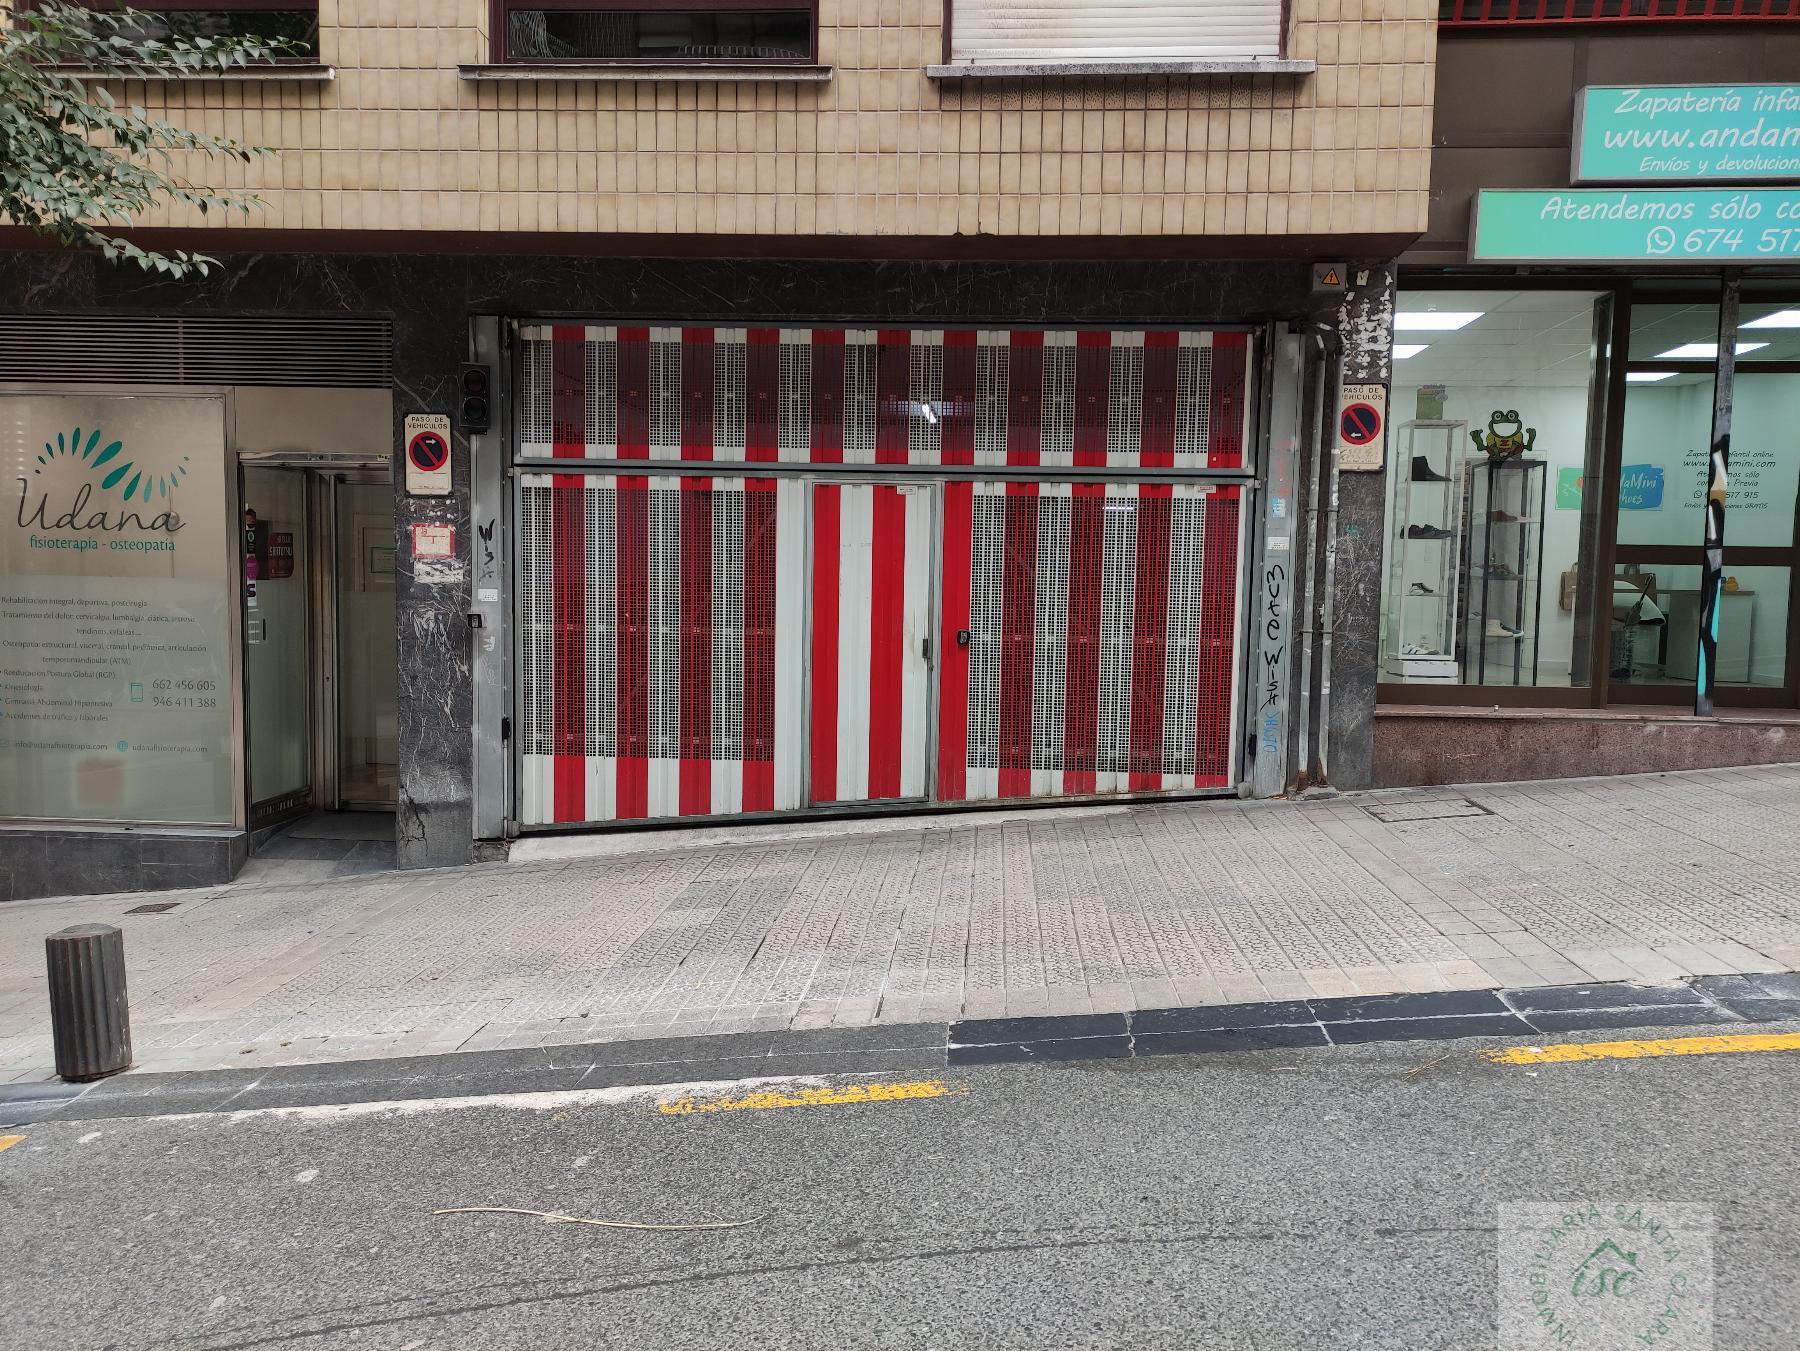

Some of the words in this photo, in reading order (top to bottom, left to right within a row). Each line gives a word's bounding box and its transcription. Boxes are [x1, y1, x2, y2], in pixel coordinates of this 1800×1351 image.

[1614, 88, 1742, 120] Zapatería
[1639, 156, 1691, 172] Envíos
[1697, 160, 1709, 176] y
[1540, 193, 1695, 220] Atendemos
[1709, 194, 1762, 220] sólo
[1683, 228, 1743, 252] 674
[1342, 393, 1383, 401] EHICULOS
[407, 422, 448, 430] VEHICULOS
[16, 478, 186, 532] Udana
[30, 534, 98, 551] fisioterapia
[110, 537, 175, 553] osteopatía
[152, 679, 173, 690] 662
[174, 680, 194, 690] 456
[196, 680, 216, 691] 605
[153, 696, 173, 707] 946
[174, 697, 194, 708] 411
[197, 698, 217, 708] 388
